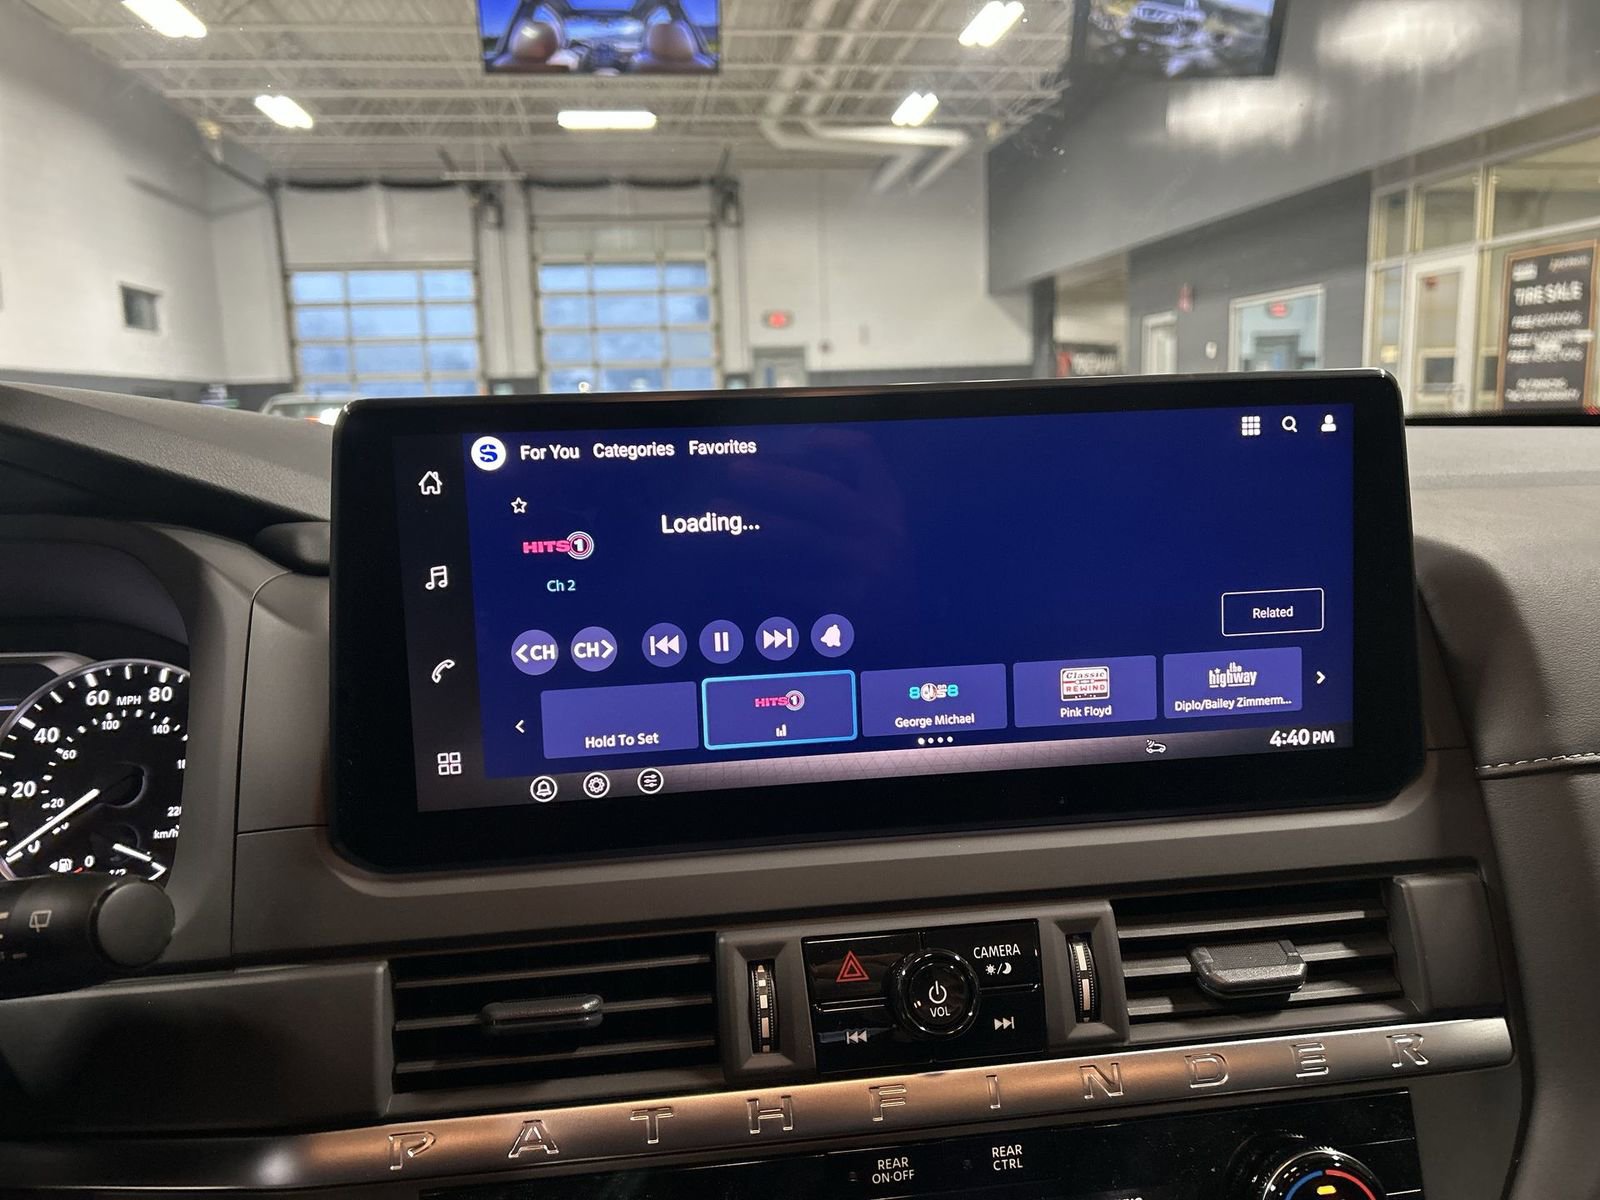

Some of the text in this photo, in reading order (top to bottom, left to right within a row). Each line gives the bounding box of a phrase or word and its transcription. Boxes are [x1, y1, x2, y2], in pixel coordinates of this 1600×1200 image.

[520, 444, 580, 460] For You
[593, 442, 675, 461] Categories
[689, 439, 757, 456] Favorites
[661, 512, 760, 535] Loading...
[547, 580, 576, 592] Ch 2
[1252, 606, 1294, 619] Related
[1229, 662, 1242, 672] the
[1065, 670, 1105, 679] Classic
[1209, 668, 1257, 688] highway
[149, 687, 173, 702] 80
[1065, 684, 1106, 693] REWIND
[86, 690, 110, 706] 60
[116, 695, 142, 706] MPH
[1060, 705, 1112, 718] Pink Floyd
[101, 720, 120, 731] 100
[895, 713, 975, 729] George Michael
[34, 727, 60, 744] 40
[152, 725, 170, 734] 140
[585, 732, 659, 749] Hold To Set
[1270, 728, 1335, 747] 4:40 PM
[62, 750, 77, 760] 60
[12, 781, 37, 798] 20
[50, 798, 64, 808] 20
[167, 806, 181, 817] 22
[153, 829, 179, 840] km/h
[84, 855, 95, 867] 0
[973, 943, 1021, 959] CAMERA
[929, 1007, 950, 1018] VOL
[991, 1144, 1022, 1158] REAR
[877, 1157, 909, 1170] REAR
[993, 1158, 1023, 1171] CTRL
